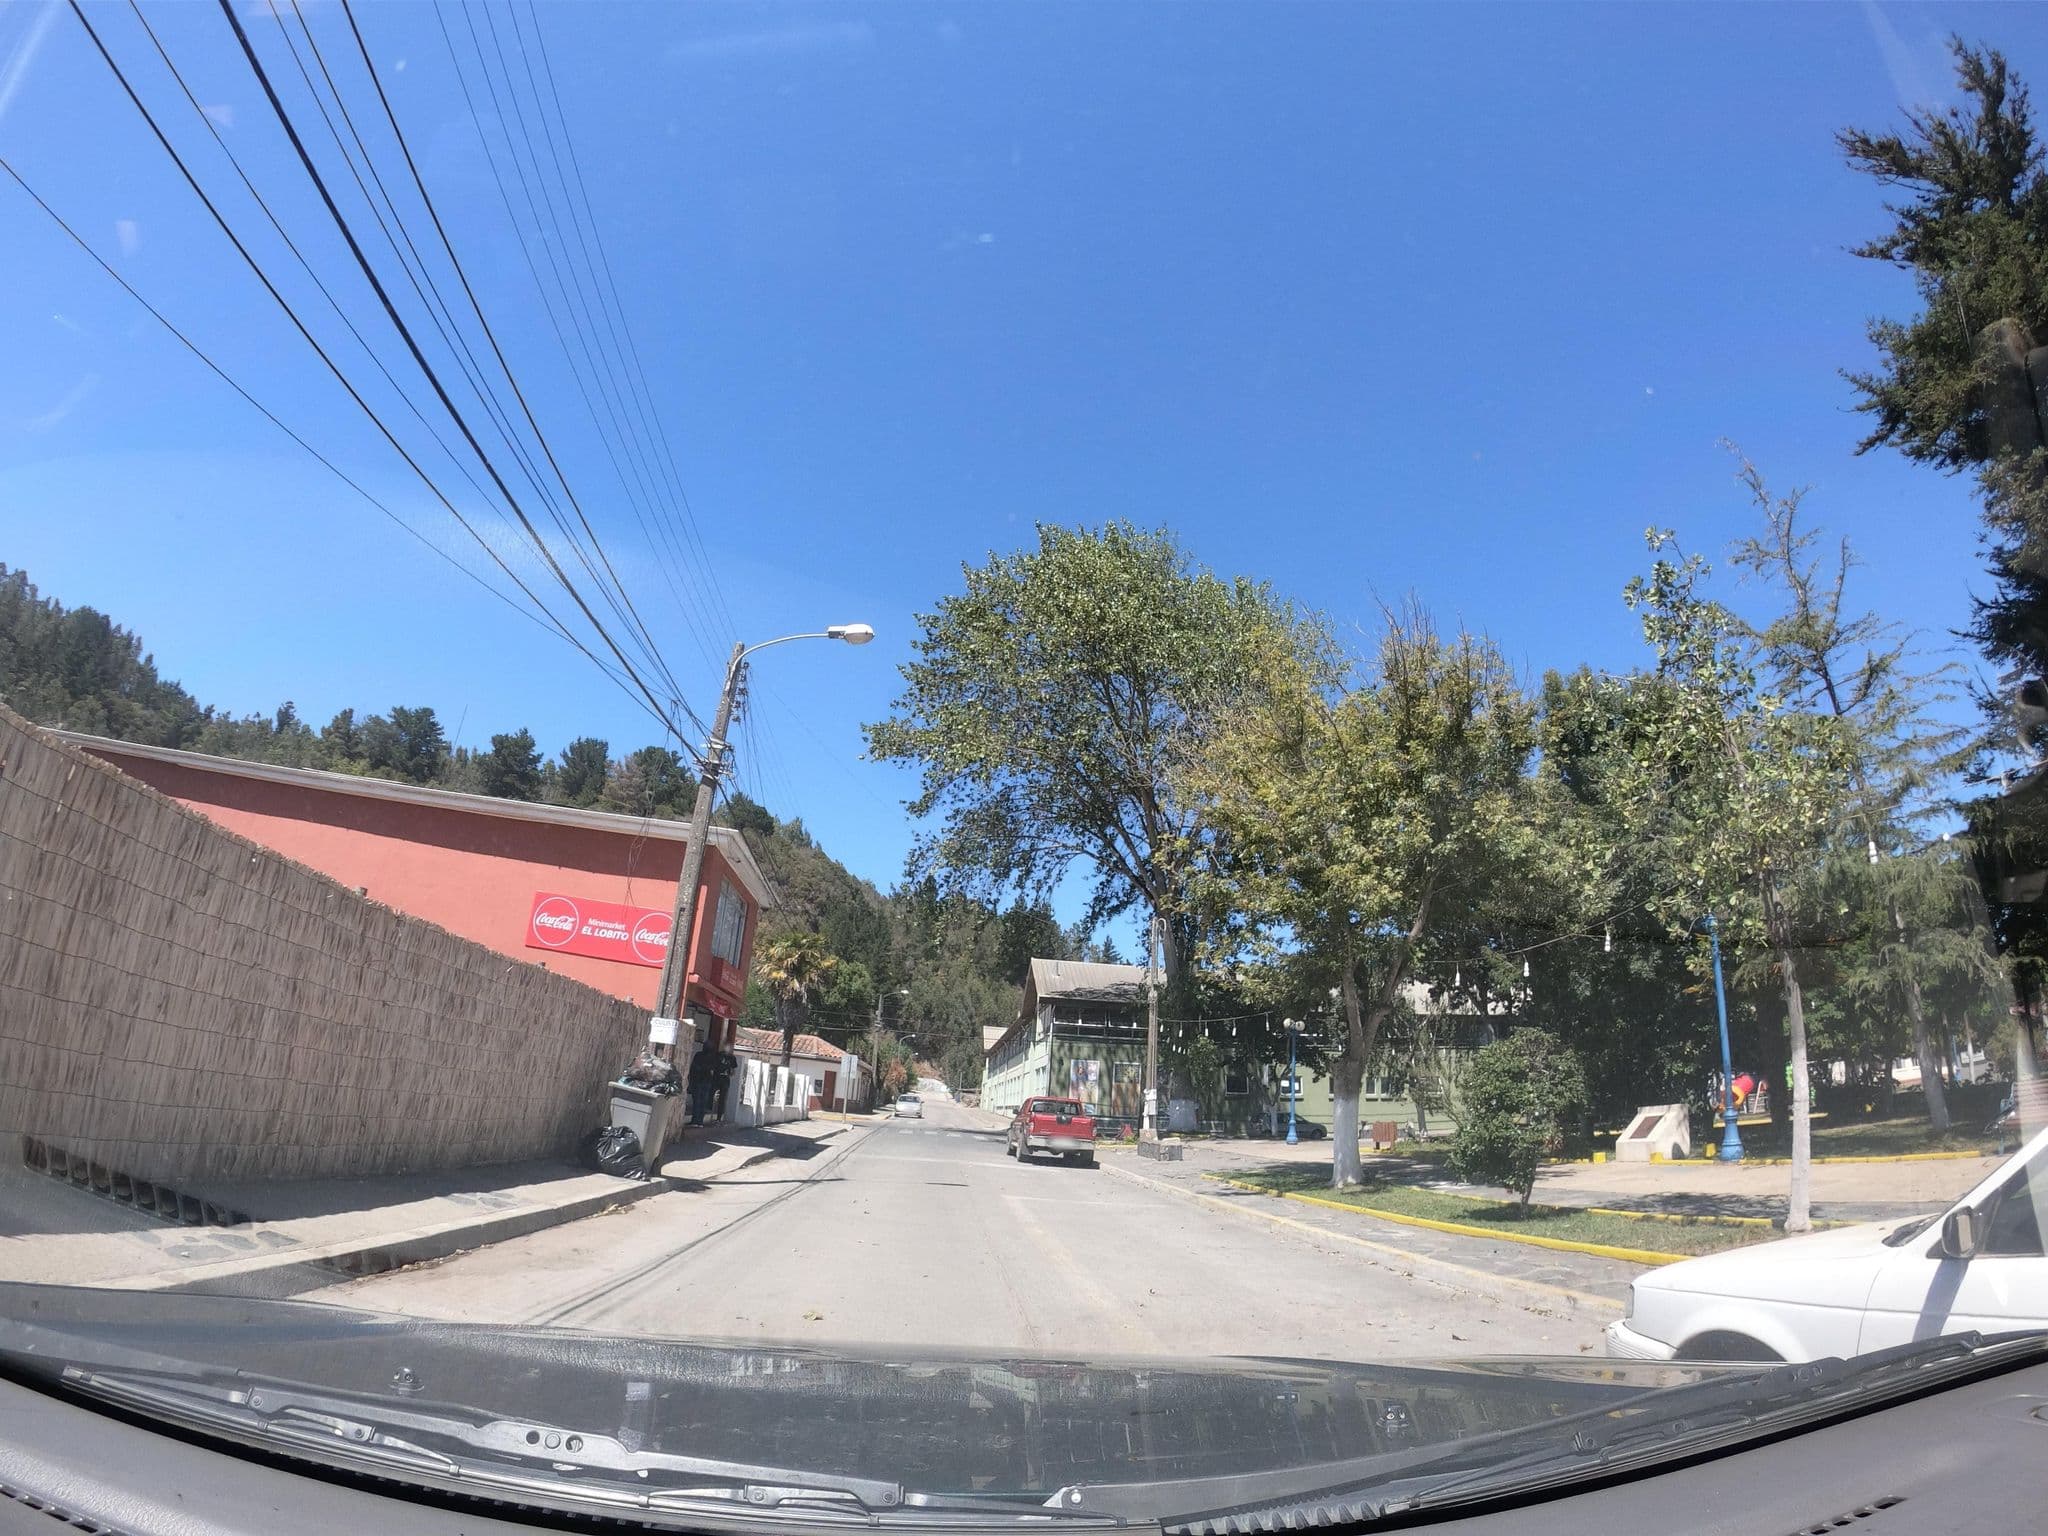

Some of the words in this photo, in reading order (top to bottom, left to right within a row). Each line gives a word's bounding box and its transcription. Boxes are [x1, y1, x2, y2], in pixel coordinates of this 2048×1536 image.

[535, 912, 576, 931] Coca-Cola
[588, 918, 626, 931] Minimarket
[581, 926, 593, 936] EL
[594, 928, 629, 941] LOBITO
